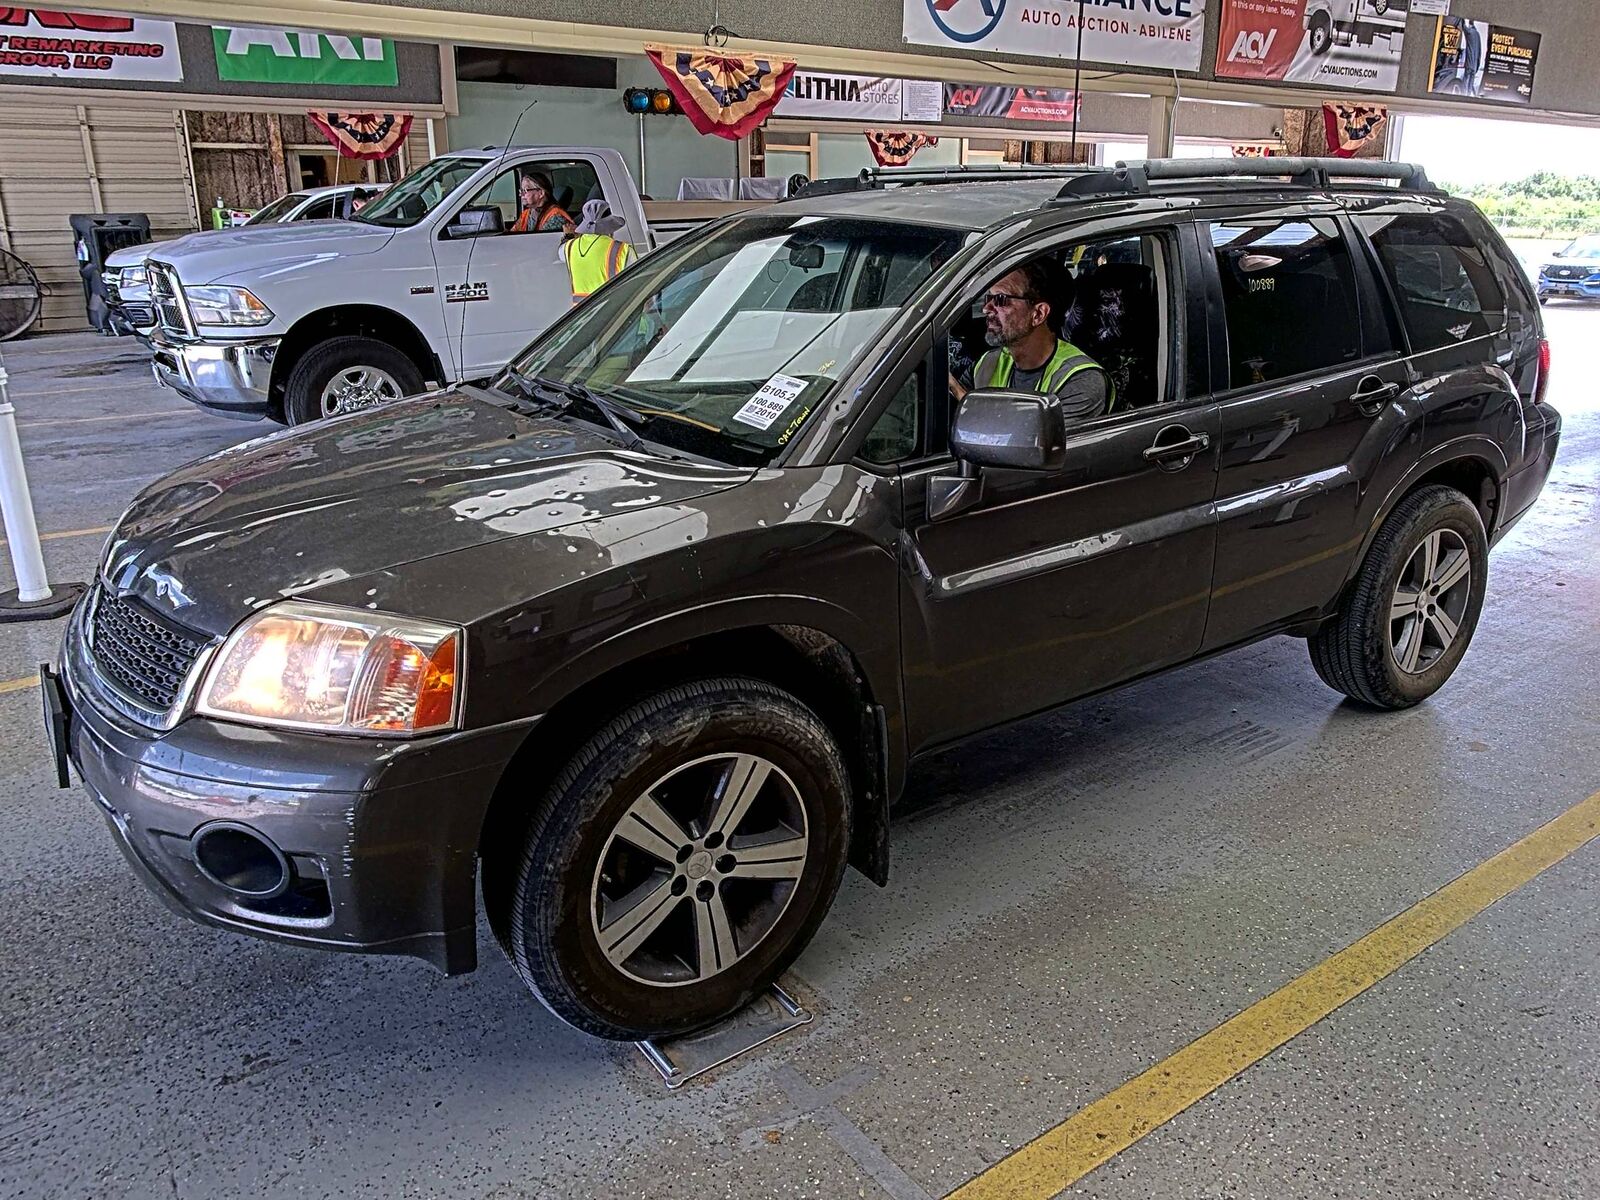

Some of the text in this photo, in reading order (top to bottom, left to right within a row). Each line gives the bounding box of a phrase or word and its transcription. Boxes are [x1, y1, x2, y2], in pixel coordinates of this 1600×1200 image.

[1238, 1, 1248, 10] this
[1255, 4, 1265, 14] any
[1280, 6, 1297, 18] Today.
[1021, 9, 1062, 26] AUTO
[1067, 15, 1129, 34] AUCTION
[1139, 24, 1192, 42] ABILENE
[9, 36, 164, 57] REMARKETING
[1226, 28, 1278, 62] ACV
[1492, 33, 1515, 46] PROTECT
[1491, 43, 1507, 54] EVERY
[73, 55, 113, 70] LLC
[795, 76, 861, 102] LITHIA
[864, 82, 889, 92] AUTO
[863, 93, 899, 104] STORES
[948, 87, 984, 107] ACV
[445, 282, 487, 291] RAM
[1248, 277, 1275, 294] 100889
[446, 290, 488, 298] 2500
[761, 385, 796, 402] B105.2
[752, 396, 784, 412] 100,889
[755, 408, 777, 420] 2010
